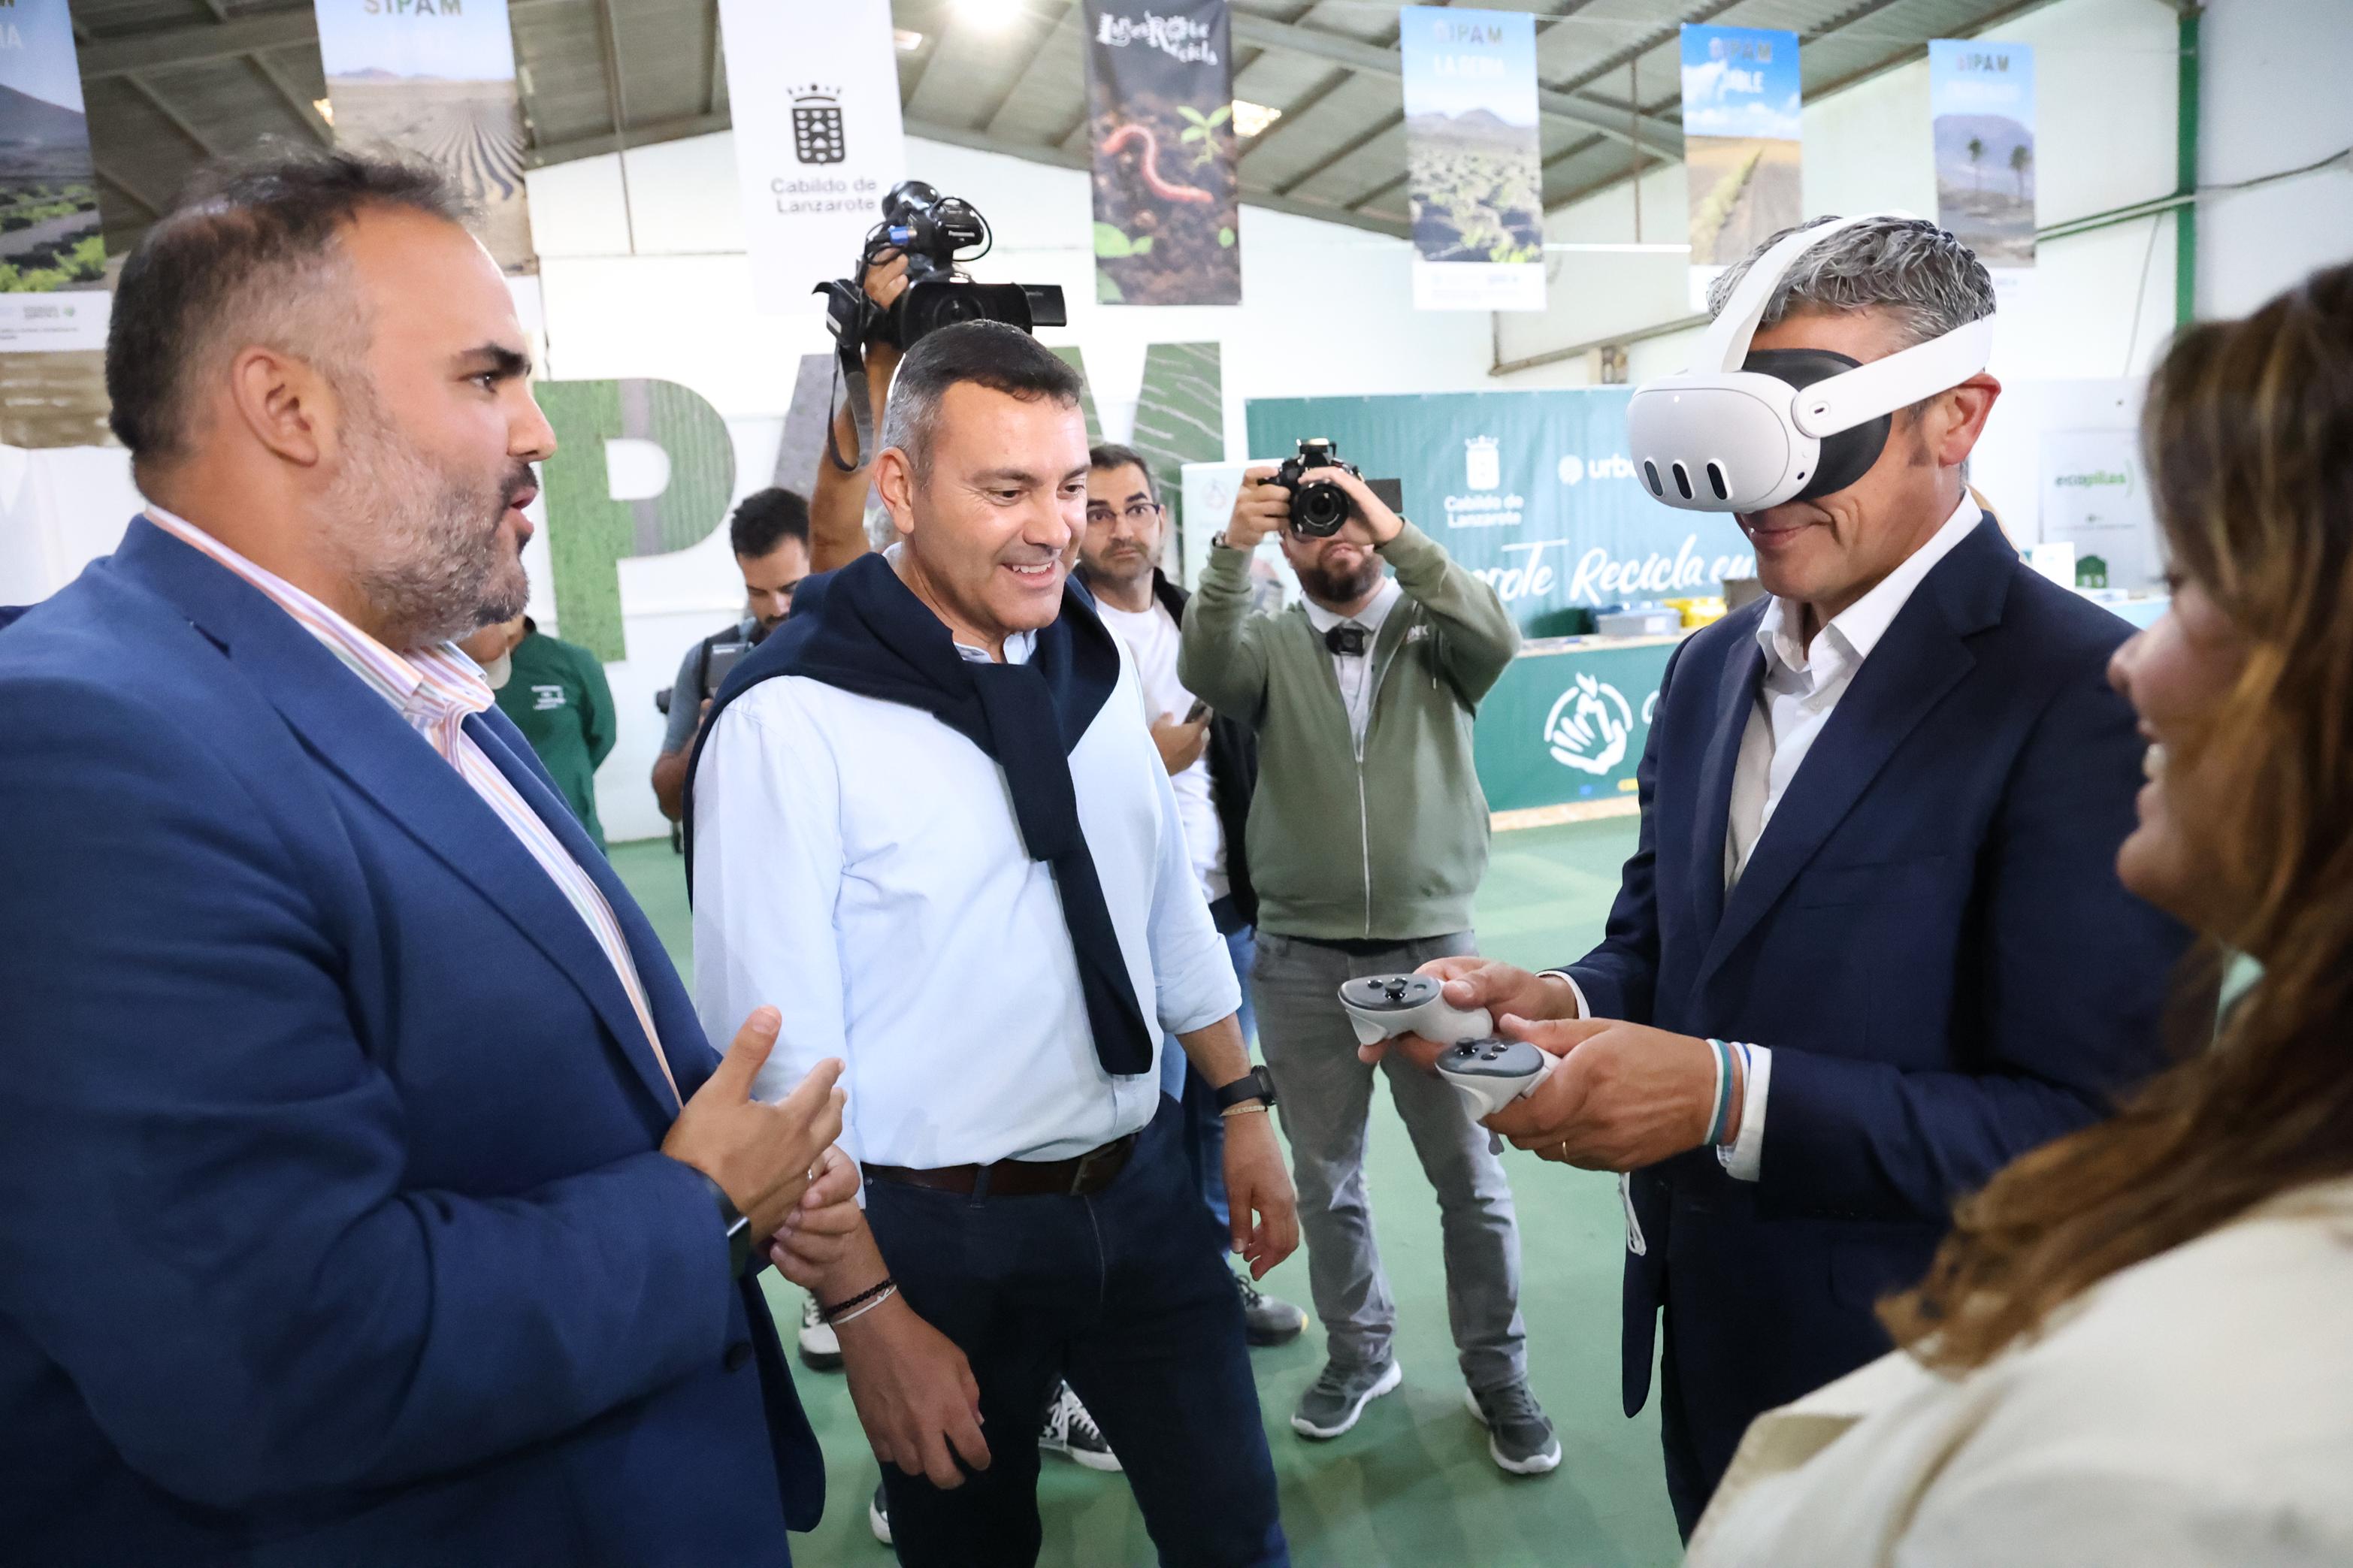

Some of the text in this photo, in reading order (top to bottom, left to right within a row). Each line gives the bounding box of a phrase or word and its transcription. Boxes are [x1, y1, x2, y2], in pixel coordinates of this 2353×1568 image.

[772, 176, 876, 194] Cabildo de
[777, 196, 876, 214] Lanzarote
[1444, 493, 1524, 512] Cabildo de
[1447, 511, 1523, 529] Lanzarote
[1569, 533, 1704, 607] Recicla
